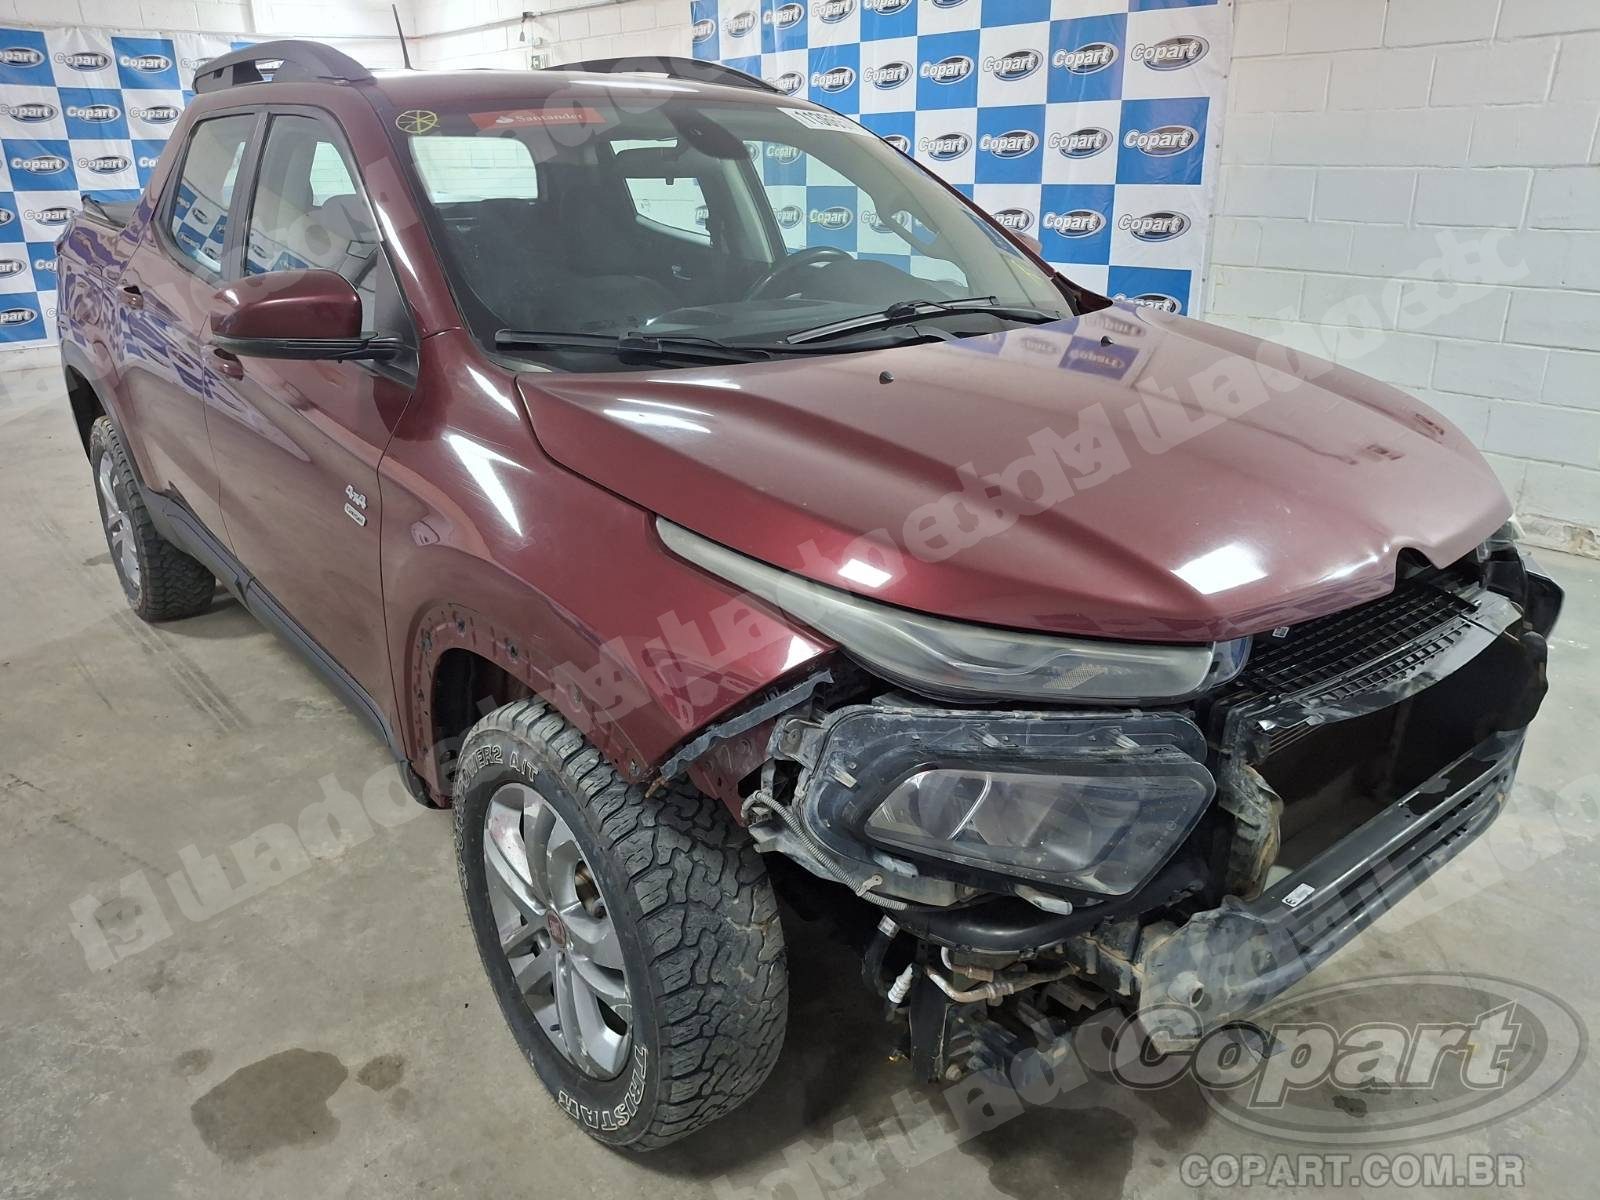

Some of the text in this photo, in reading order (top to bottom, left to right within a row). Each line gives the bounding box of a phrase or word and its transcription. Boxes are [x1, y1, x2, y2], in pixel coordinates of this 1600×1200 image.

[763, 9, 800, 25] Copart
[692, 23, 712, 37] part
[54, 52, 107, 69] Copart
[1053, 45, 1109, 69] Copart
[1131, 40, 1200, 64] Copart
[119, 55, 167, 70] Copart
[920, 58, 968, 80] Copart
[983, 52, 1037, 75] Copart
[810, 69, 851, 88] Copart
[864, 65, 907, 86] Copart
[0, 104, 50, 121] Copart
[67, 105, 116, 121] Copart
[130, 106, 176, 121] Copart
[918, 136, 966, 155] Copart
[980, 133, 1032, 154] Copart
[1048, 131, 1103, 152] Copart
[1123, 128, 1194, 150] Copart
[11, 157, 63, 171] Copart
[78, 157, 125, 171] Copart
[24, 209, 73, 223] Copart
[809, 209, 848, 226] Copart
[992, 209, 1030, 229] part
[1043, 211, 1098, 232] Copart
[1118, 214, 1183, 236] Copart
[0, 309, 34, 324] part
[558, 1044, 648, 1131] TRISTAR
